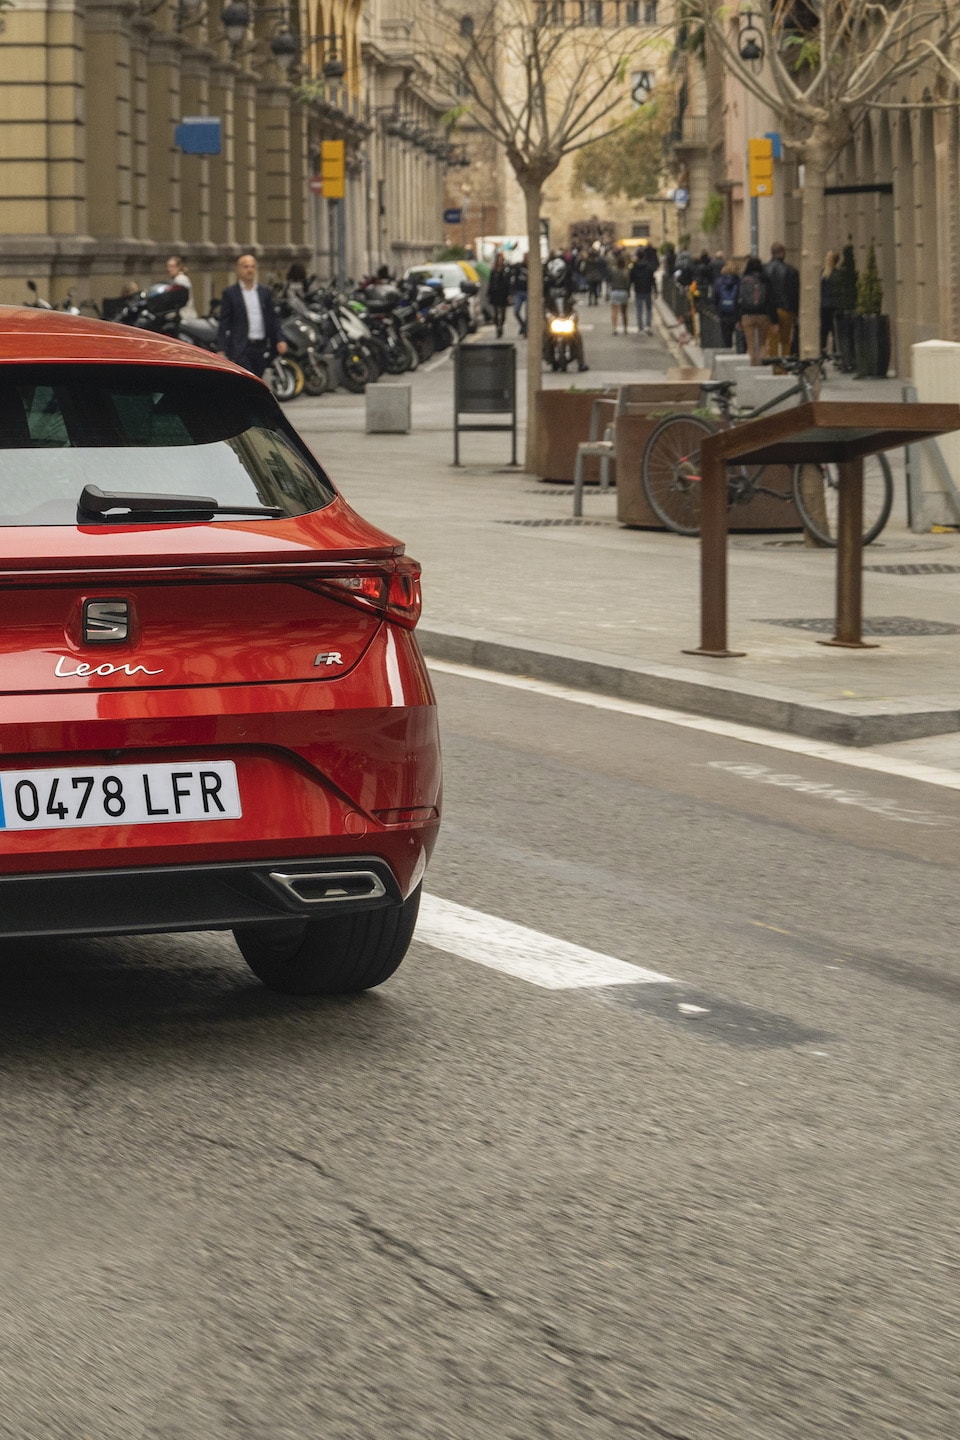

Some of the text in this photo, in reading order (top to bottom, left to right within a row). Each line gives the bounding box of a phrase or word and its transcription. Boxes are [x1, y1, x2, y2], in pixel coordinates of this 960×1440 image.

[54, 656, 164, 677] Leon
[313, 652, 343, 666] FR
[14, 770, 226, 822] 0478 LFR
